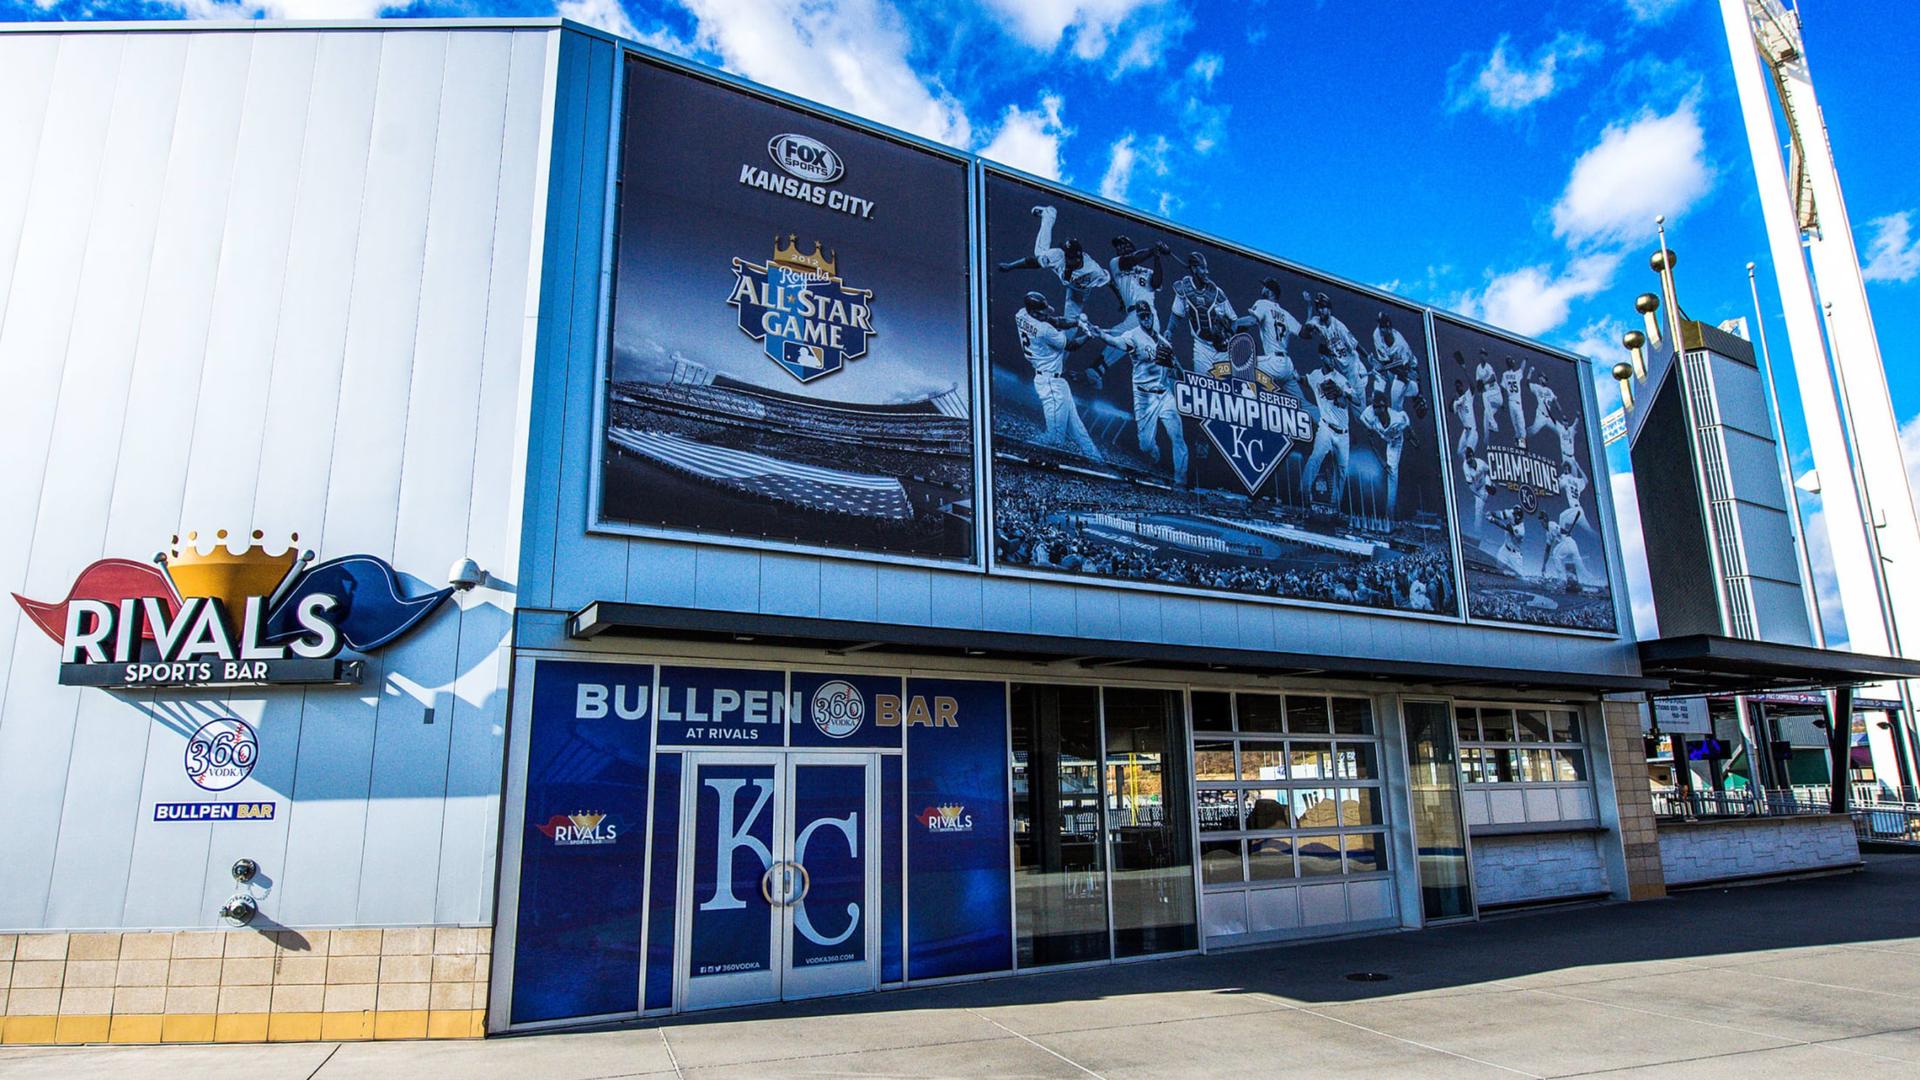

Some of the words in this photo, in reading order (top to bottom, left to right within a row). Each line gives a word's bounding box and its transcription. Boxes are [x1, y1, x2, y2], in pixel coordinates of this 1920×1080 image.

[785, 140, 828, 168] FOX
[785, 158, 828, 177] SPORTS
[739, 164, 826, 206] KANSAS
[828, 190, 874, 219] CITY
[791, 254, 818, 266] 2012
[778, 265, 831, 291] Royals
[734, 275, 791, 313] ALL
[797, 290, 869, 331] STAR
[761, 311, 845, 349] GAME
[1187, 373, 1231, 394] WORLD
[1259, 391, 1298, 409] SERIES
[1176, 383, 1312, 441] CHAMPIONS
[1230, 425, 1266, 473] KC
[1487, 445, 1525, 456] AMERICAN
[1528, 452, 1557, 466] LEAGUE
[1487, 452, 1560, 495] CHAMPIONS
[61, 593, 339, 664] RIVALS
[125, 662, 212, 682] SPORTS
[224, 662, 268, 681] BAR
[575, 682, 803, 725] BULLPEN
[875, 694, 959, 728] BAR
[815, 691, 863, 725] 360
[686, 728, 705, 740] AT
[709, 728, 759, 740] RIVALS
[187, 731, 258, 777] 360
[209, 768, 245, 777] VODKA
[156, 804, 233, 819] BULLPEN
[236, 803, 274, 819] BAR
[929, 815, 973, 829] RIVALS
[555, 825, 617, 841] RIVALS
[722, 961, 761, 972] 360VODKA
[805, 953, 855, 965] VODKA360.COM
